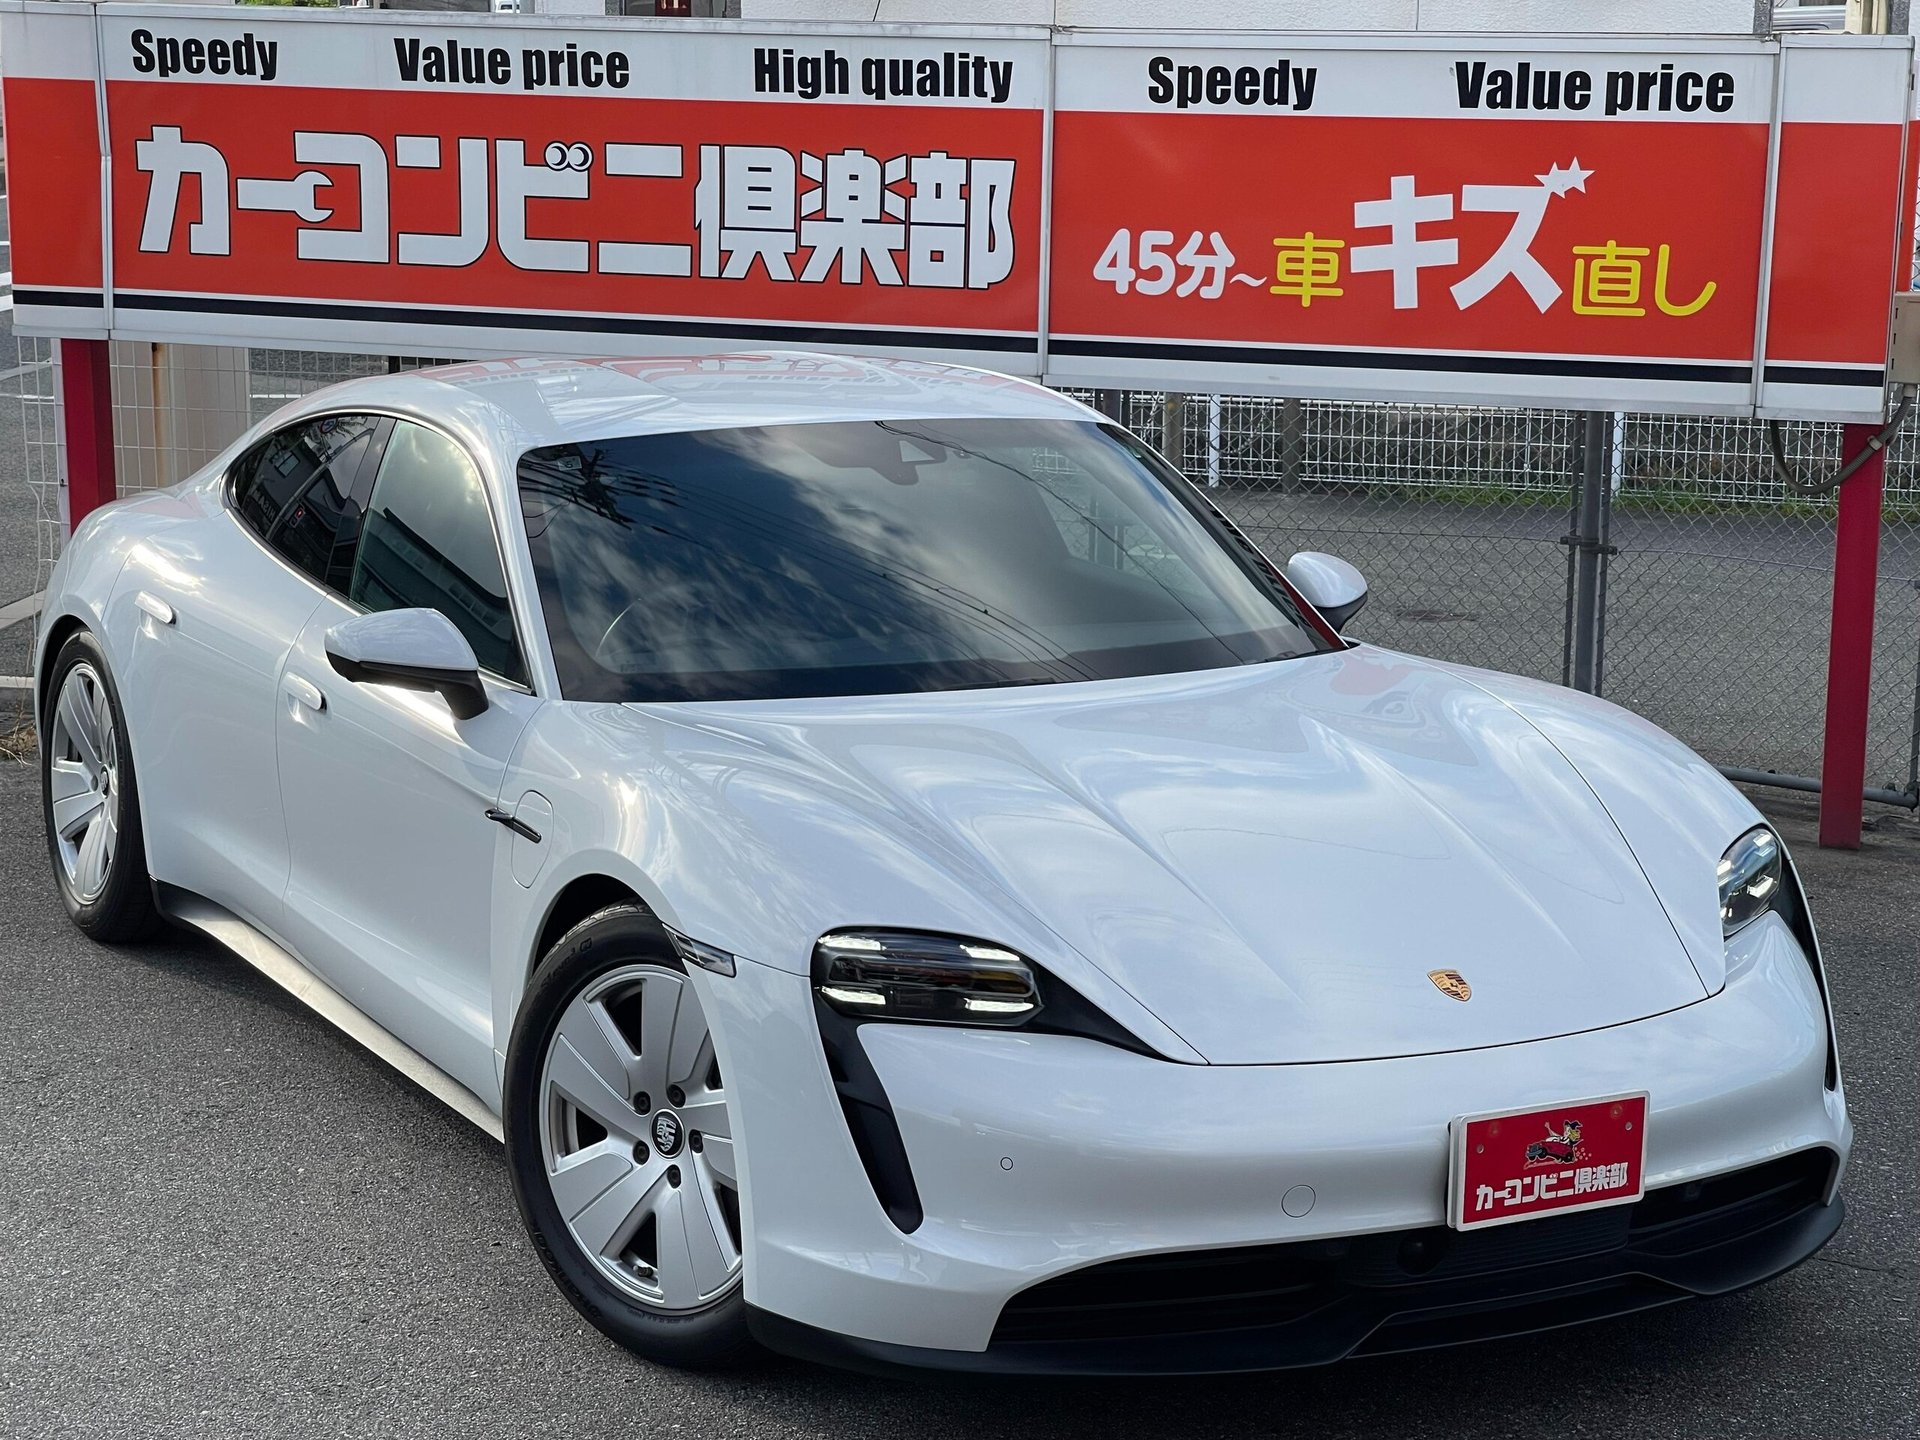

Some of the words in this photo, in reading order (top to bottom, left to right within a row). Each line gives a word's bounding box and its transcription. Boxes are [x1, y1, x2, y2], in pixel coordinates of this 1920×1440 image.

[132, 29, 277, 80] Speedy
[394, 38, 510, 84] Value
[523, 44, 629, 90] price
[754, 48, 849, 99] High
[862, 53, 1013, 103] quality
[1148, 57, 1317, 110] Speedy
[1456, 62, 1591, 110] Value
[1605, 65, 1734, 115] price
[136, 125, 1015, 289] カーコンビニ倶楽部
[1475, 1162, 1628, 1211] カーコンビニ倶楽部
